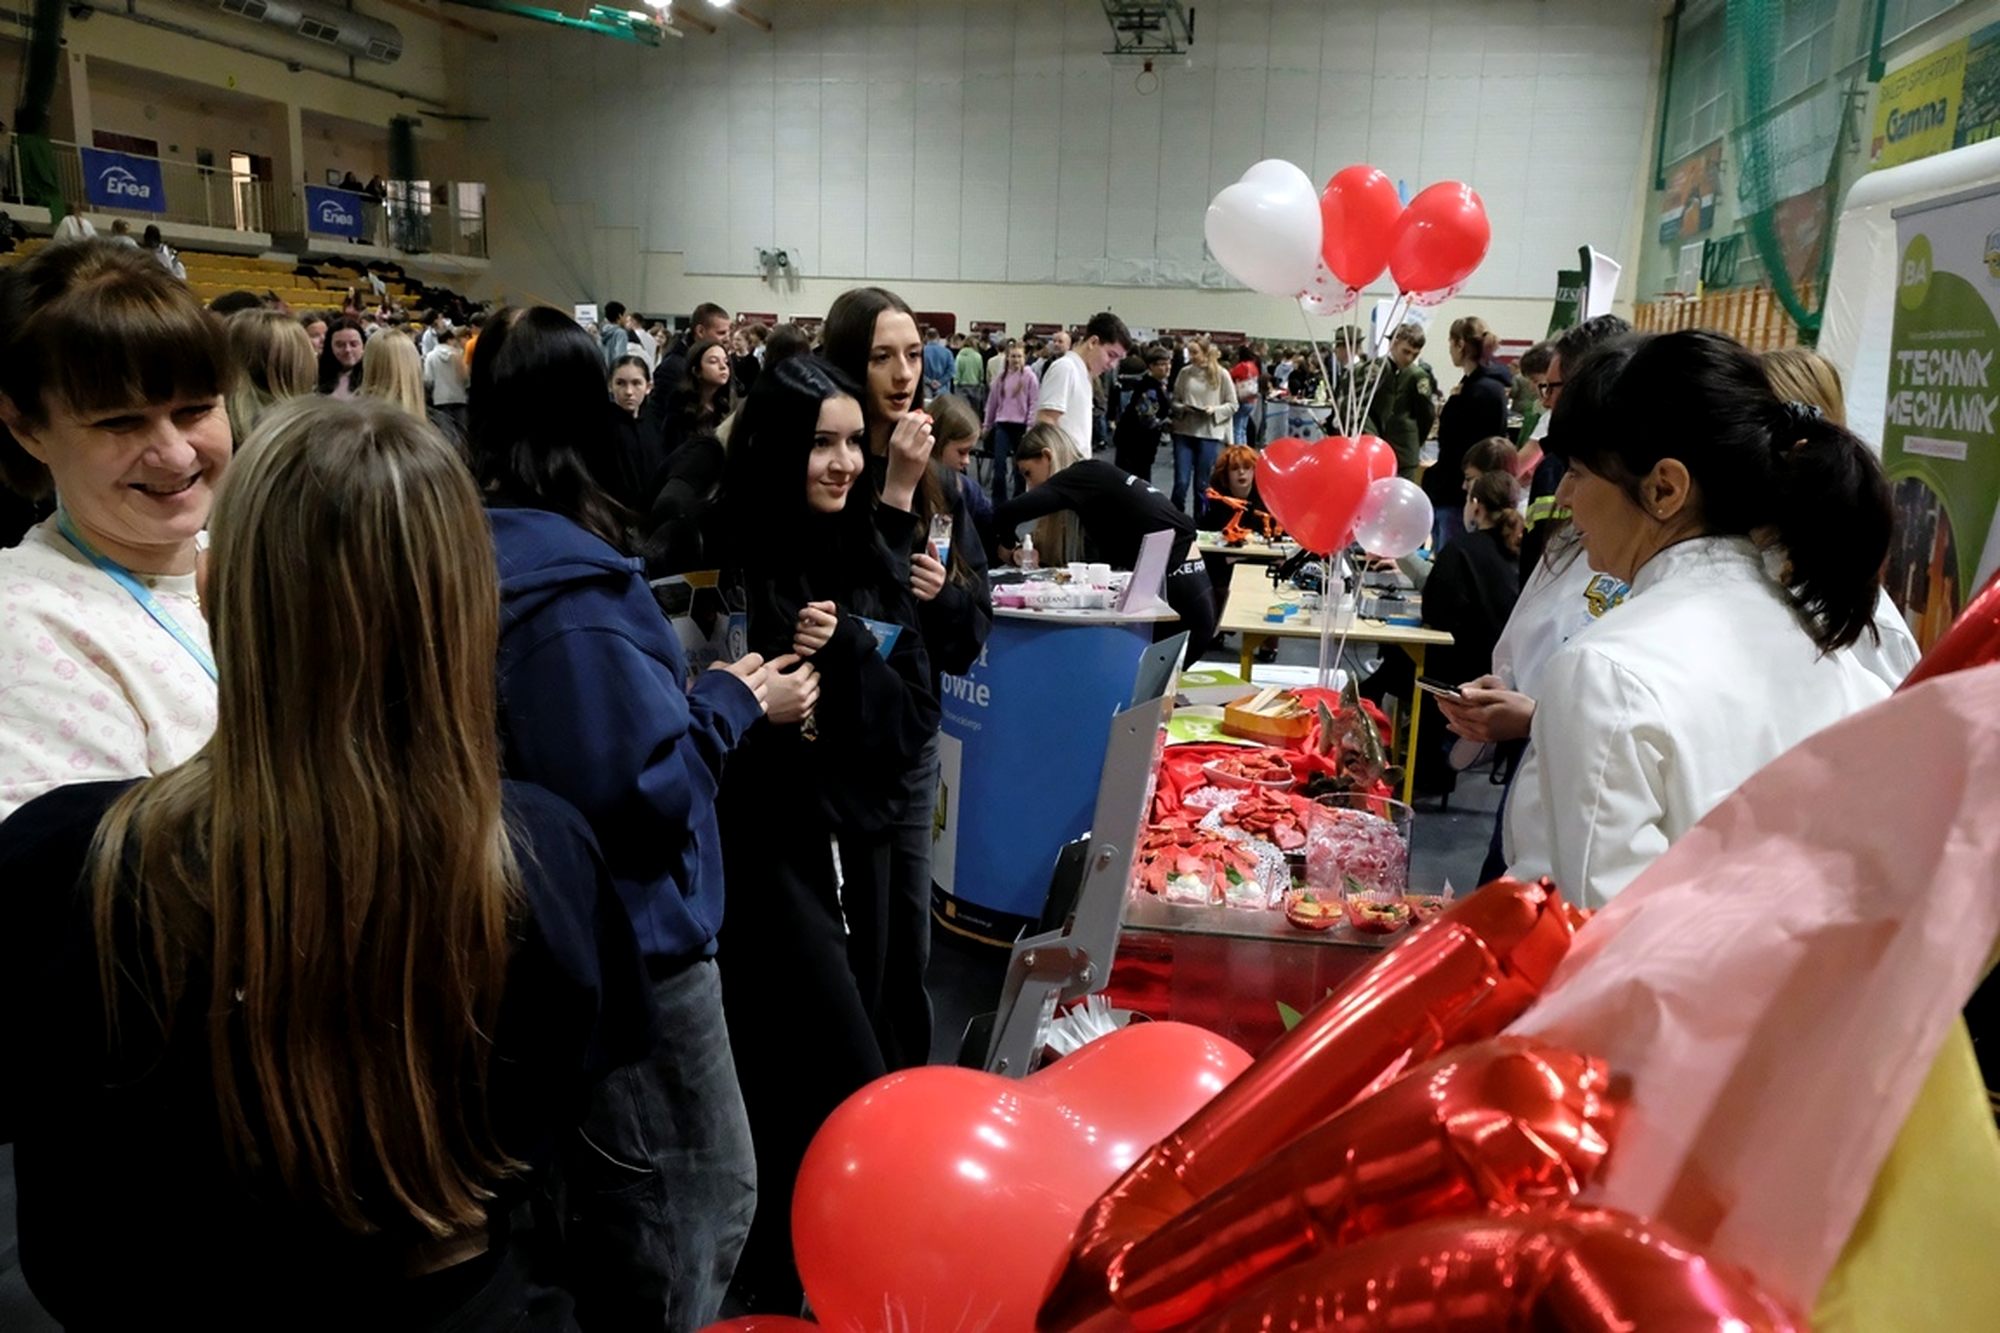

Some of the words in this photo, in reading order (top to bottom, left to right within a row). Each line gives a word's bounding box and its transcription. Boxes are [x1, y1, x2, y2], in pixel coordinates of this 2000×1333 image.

[1886, 97, 1947, 143] Gamma
[107, 176, 150, 198] Enea
[322, 208, 354, 226] Enea
[1903, 259, 1928, 287] BA
[1896, 347, 1994, 388] TECHNIK
[1884, 390, 2000, 435] MECHANIK
[940, 671, 991, 708] owie
